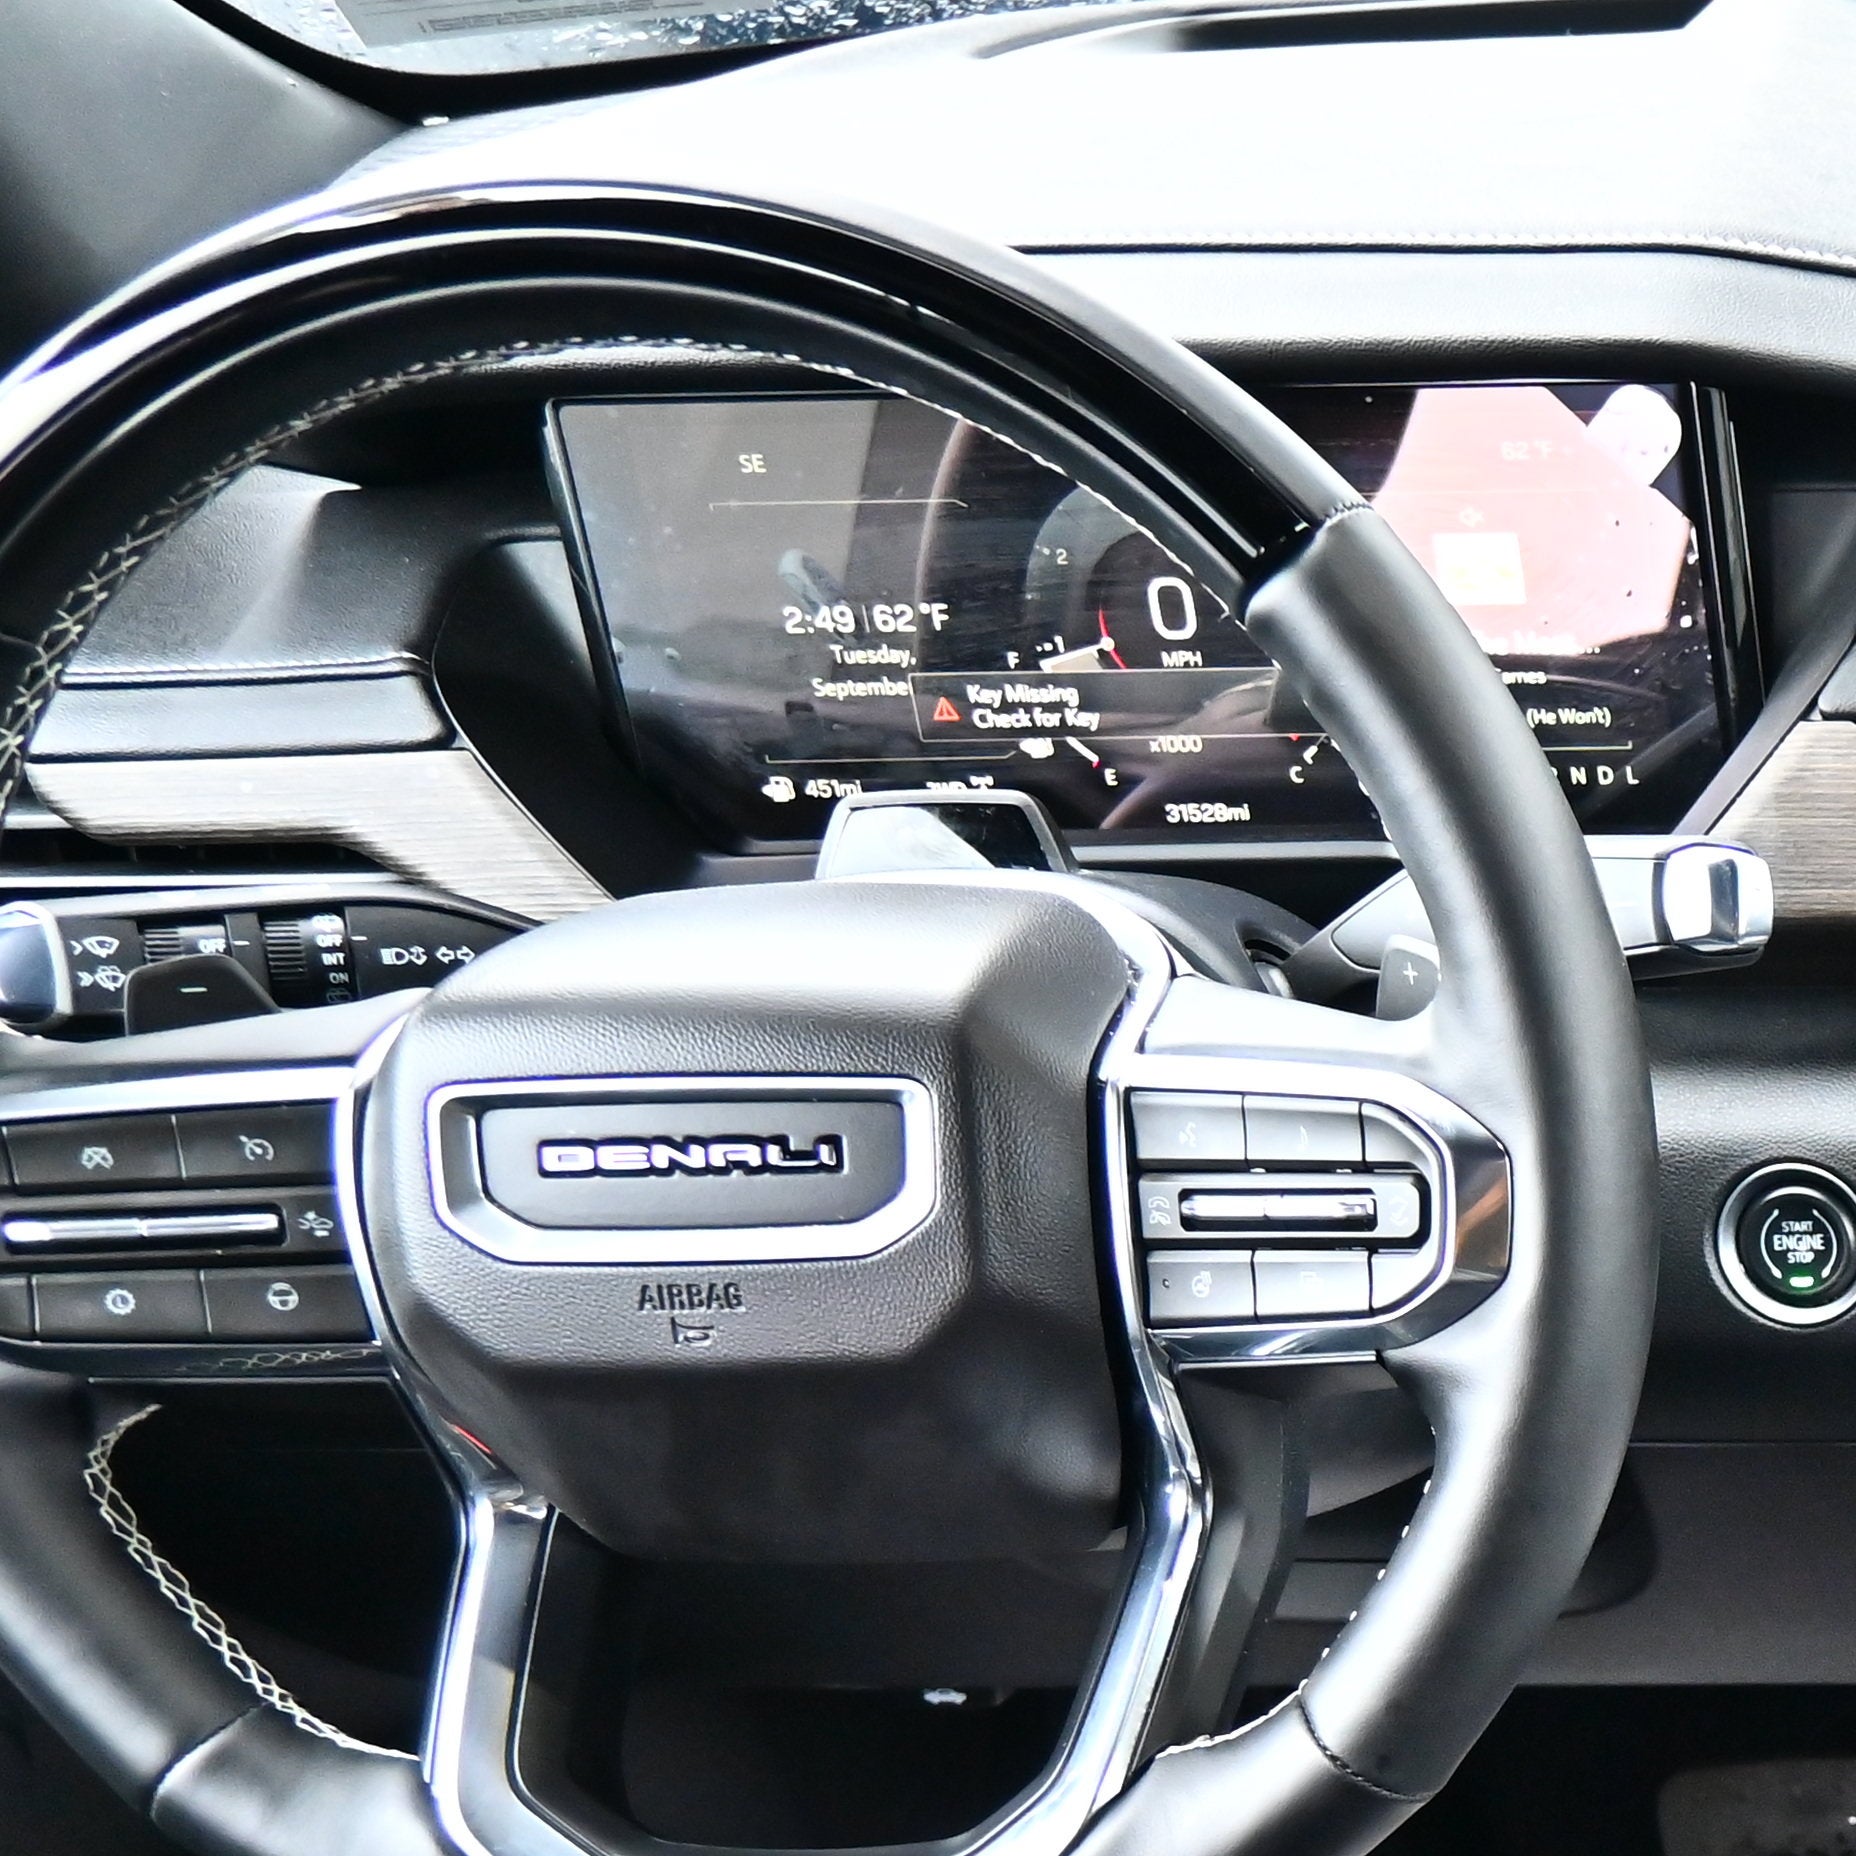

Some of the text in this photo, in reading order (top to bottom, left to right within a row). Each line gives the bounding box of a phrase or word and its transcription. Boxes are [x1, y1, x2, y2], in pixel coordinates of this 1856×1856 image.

[738, 452, 767, 473] SE
[1056, 549, 1068, 565] 2
[1147, 576, 1198, 641] 0
[783, 605, 855, 634] 2:49
[828, 644, 917, 668] Tuesday,
[1007, 652, 1020, 670] F
[1161, 650, 1203, 668] MPH
[966, 684, 1080, 706] Key Missing
[972, 707, 1100, 732] Check for Key
[1526, 707, 1557, 728] (He
[1150, 736, 1203, 753] x1000
[1105, 768, 1118, 786] E
[1570, 765, 1640, 786] N D L
[1165, 803, 1251, 824] 31528mi
[315, 934, 344, 948] OFF
[321, 952, 346, 966] INT
[329, 972, 350, 984] ON
[541, 1136, 842, 1176] DENALI
[1781, 1220, 1814, 1233] START
[1772, 1233, 1826, 1251] ENGINE
[1786, 1251, 1816, 1264] STOP
[638, 1283, 743, 1310] AIRBAG
